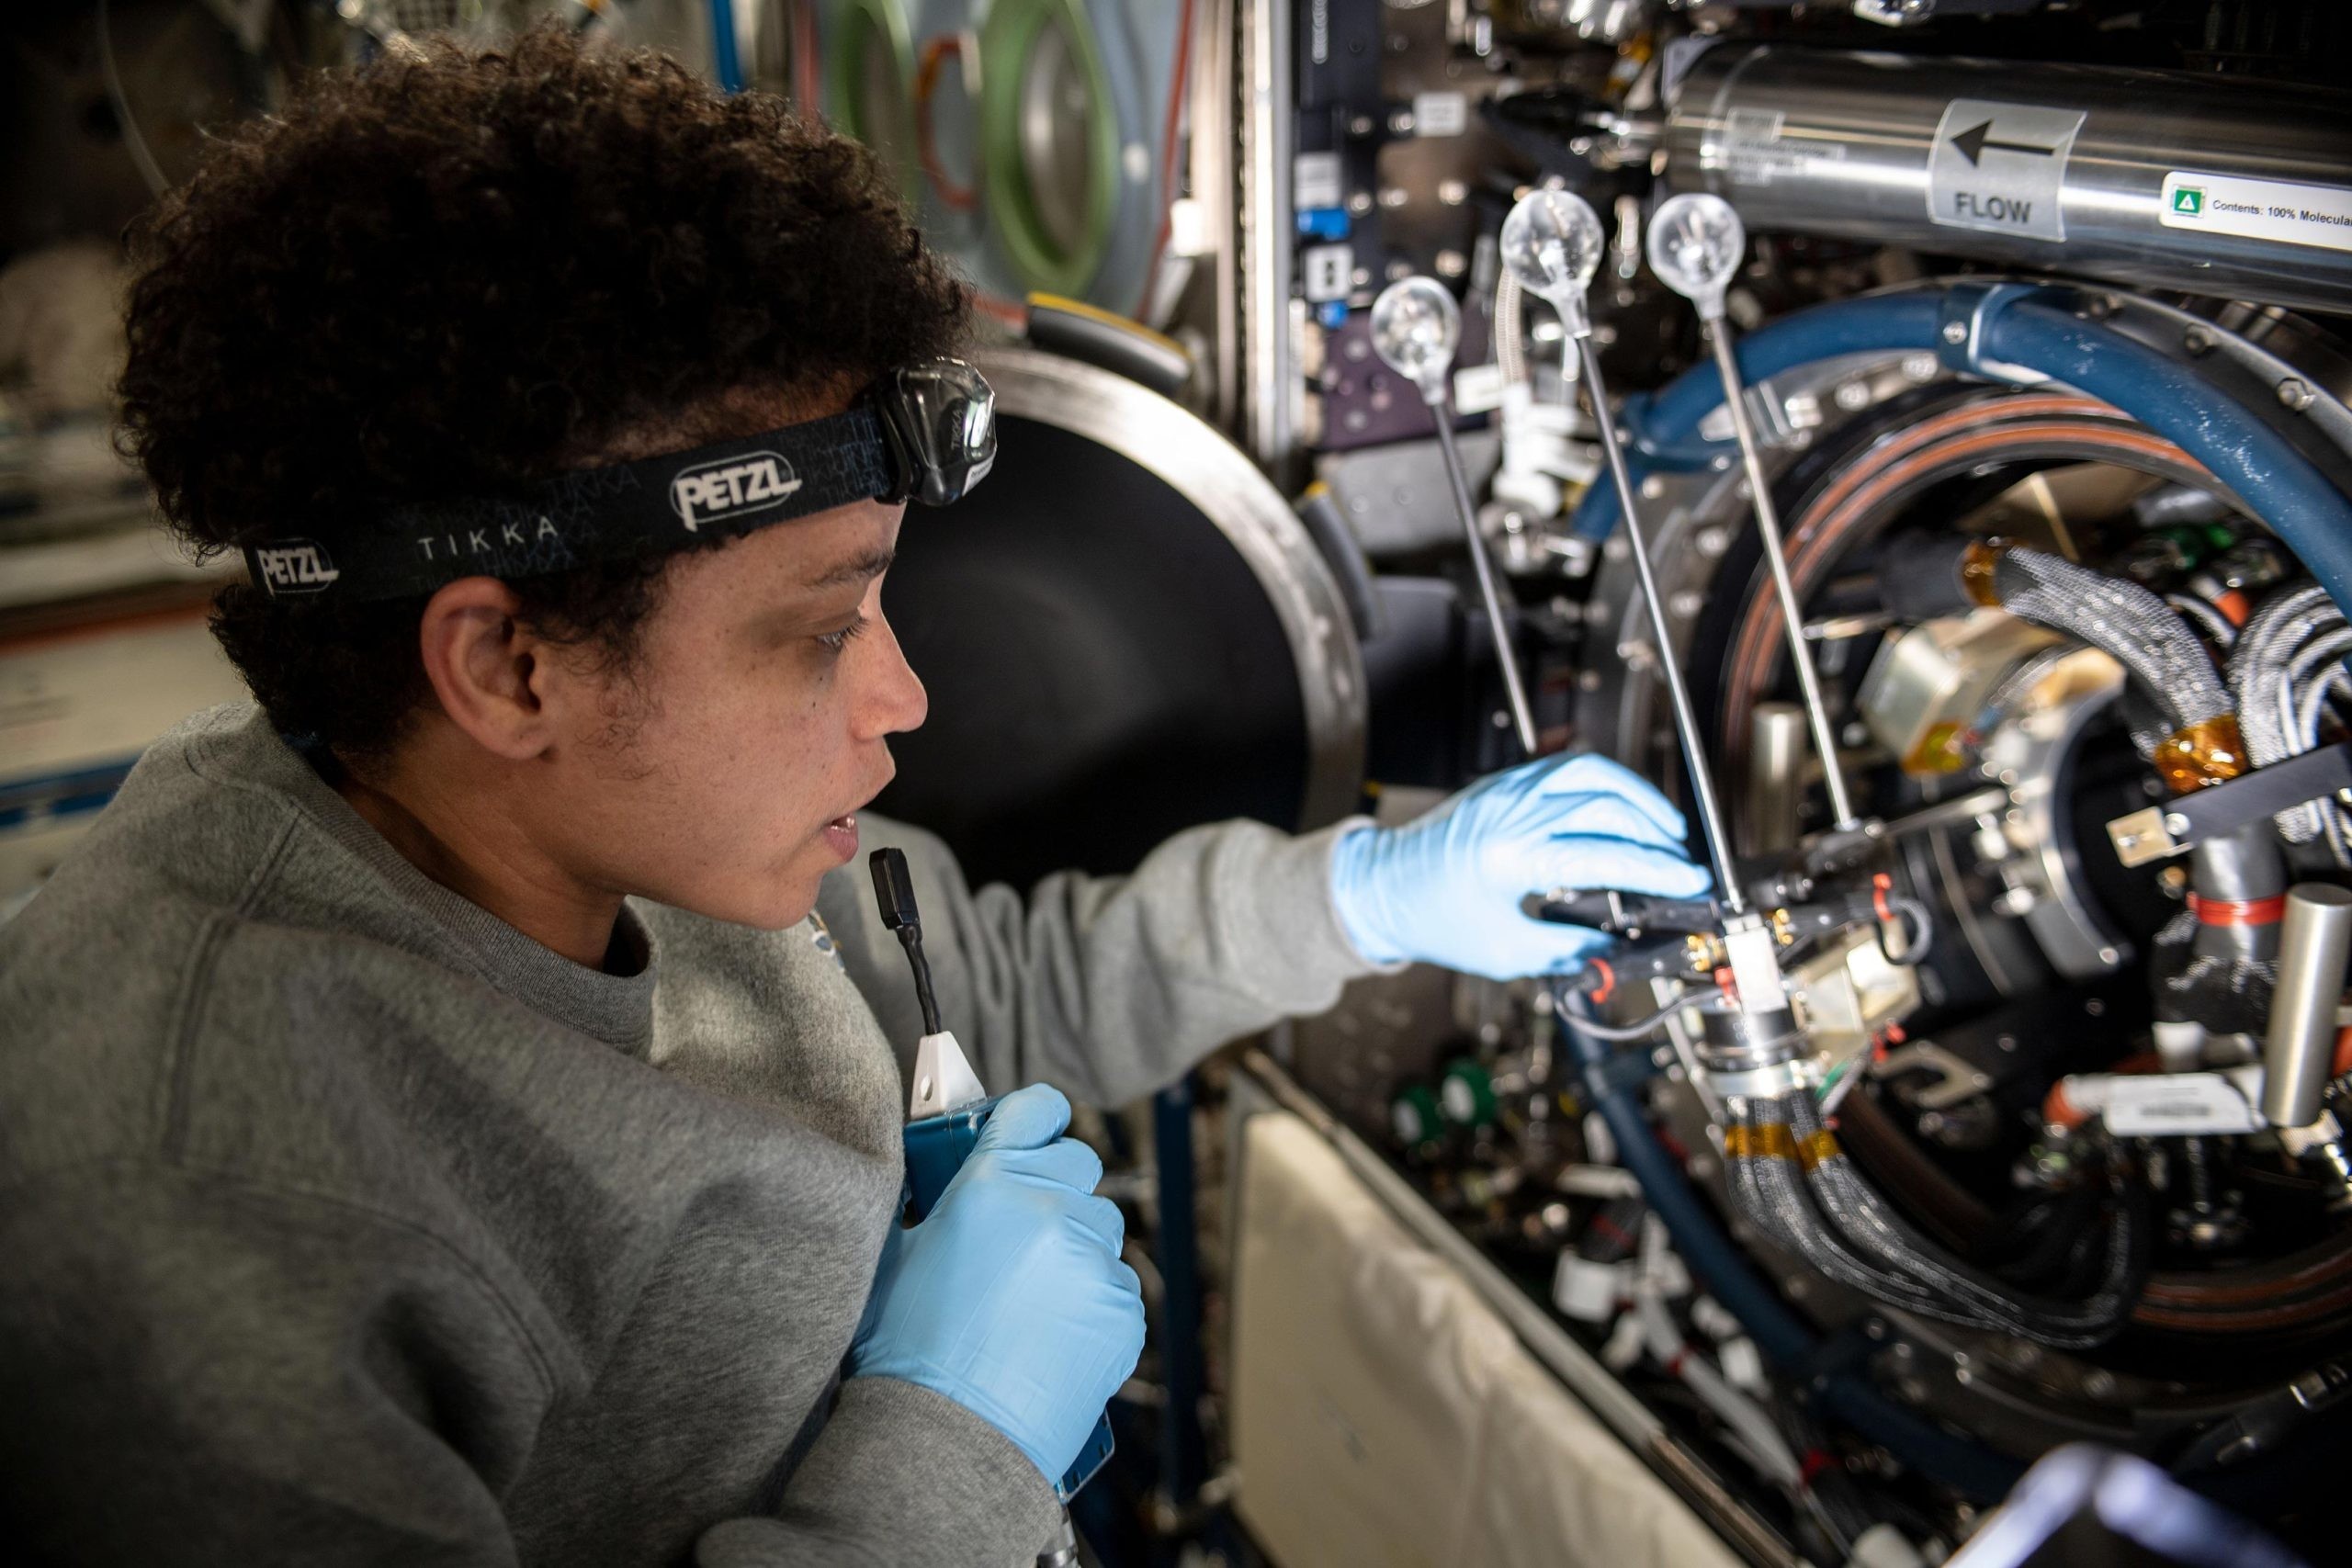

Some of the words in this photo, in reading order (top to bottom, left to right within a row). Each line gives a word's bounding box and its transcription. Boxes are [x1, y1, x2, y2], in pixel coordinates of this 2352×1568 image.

[1954, 191, 2031, 222] FLOW
[2212, 199, 2264, 216] Contents:
[2267, 206, 2296, 220] 100%
[950, 410, 964, 450] TIKKA
[676, 458, 802, 532] PETZL
[417, 515, 559, 560] TIKKA
[257, 546, 340, 597] PETZL
